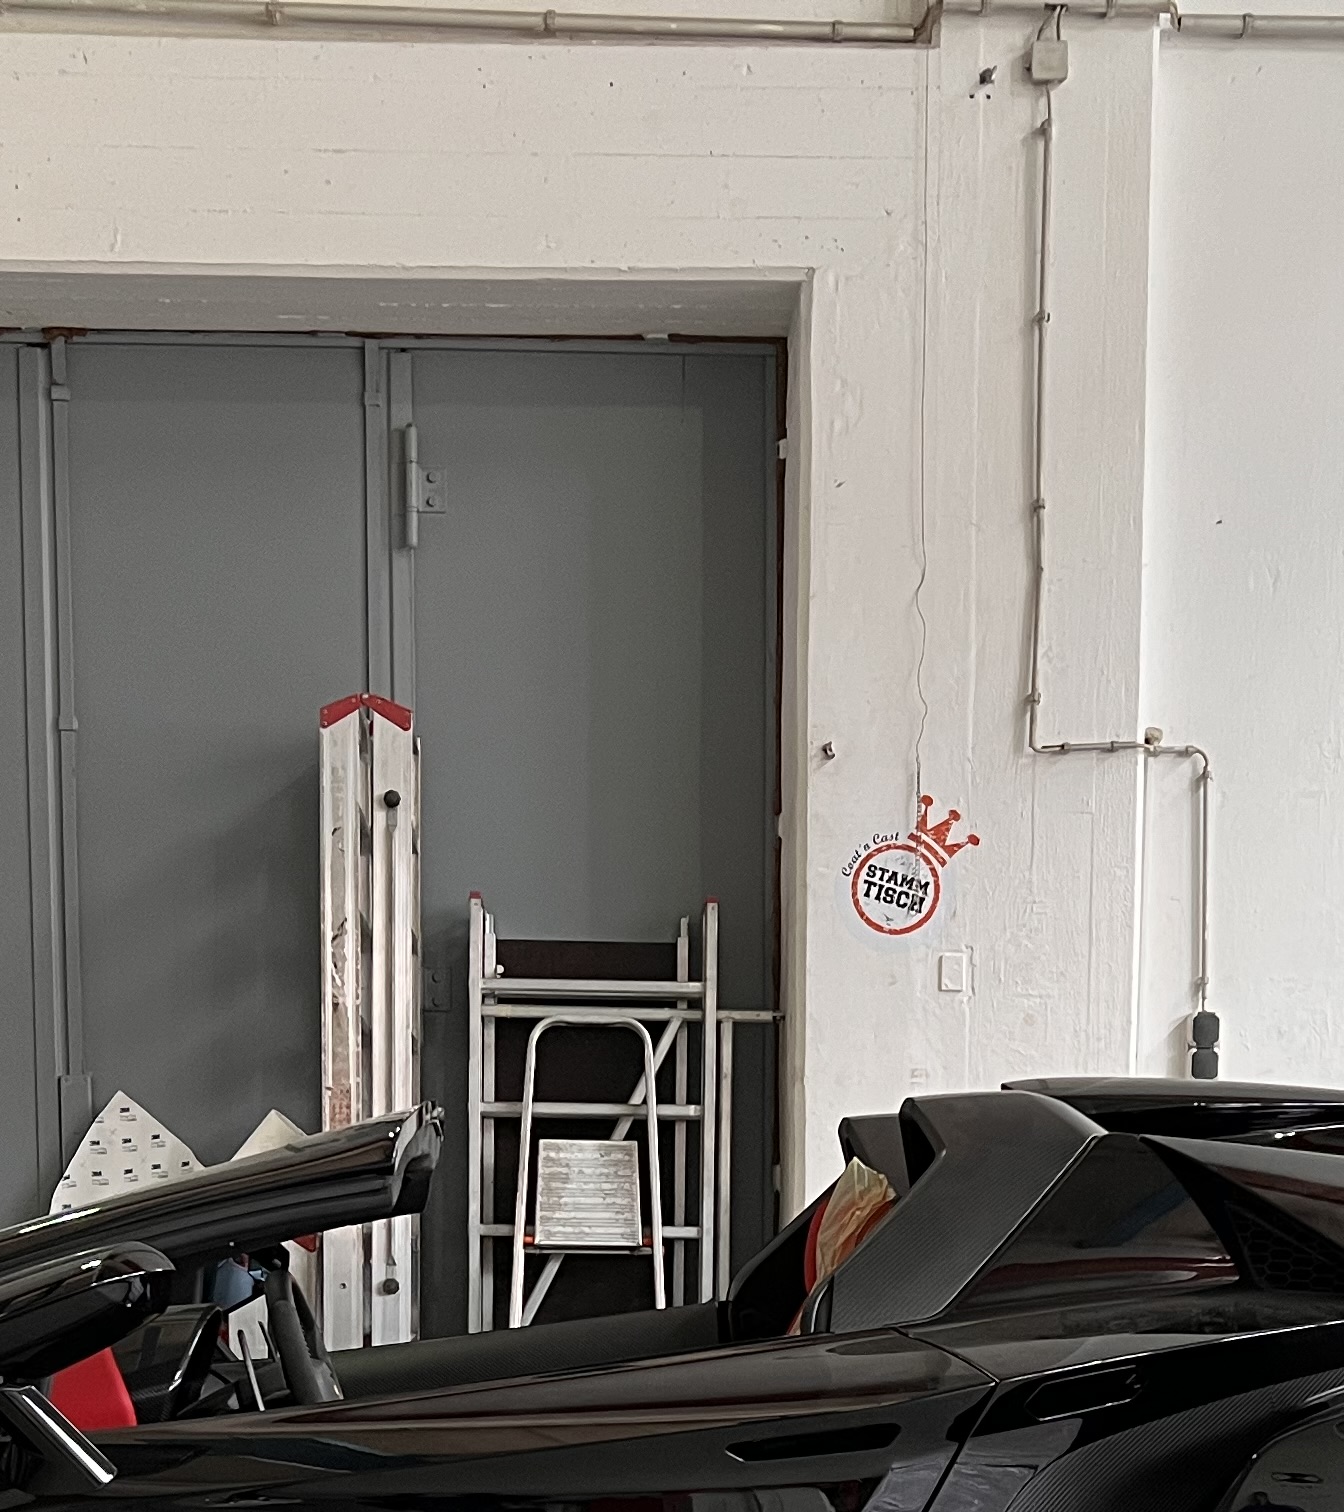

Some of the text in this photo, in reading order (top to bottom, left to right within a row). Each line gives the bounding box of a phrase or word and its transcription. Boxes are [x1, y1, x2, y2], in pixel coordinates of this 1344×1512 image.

[872, 832, 900, 845] Cast
[863, 879, 926, 914] TISCH
[865, 864, 931, 897] STAMM
